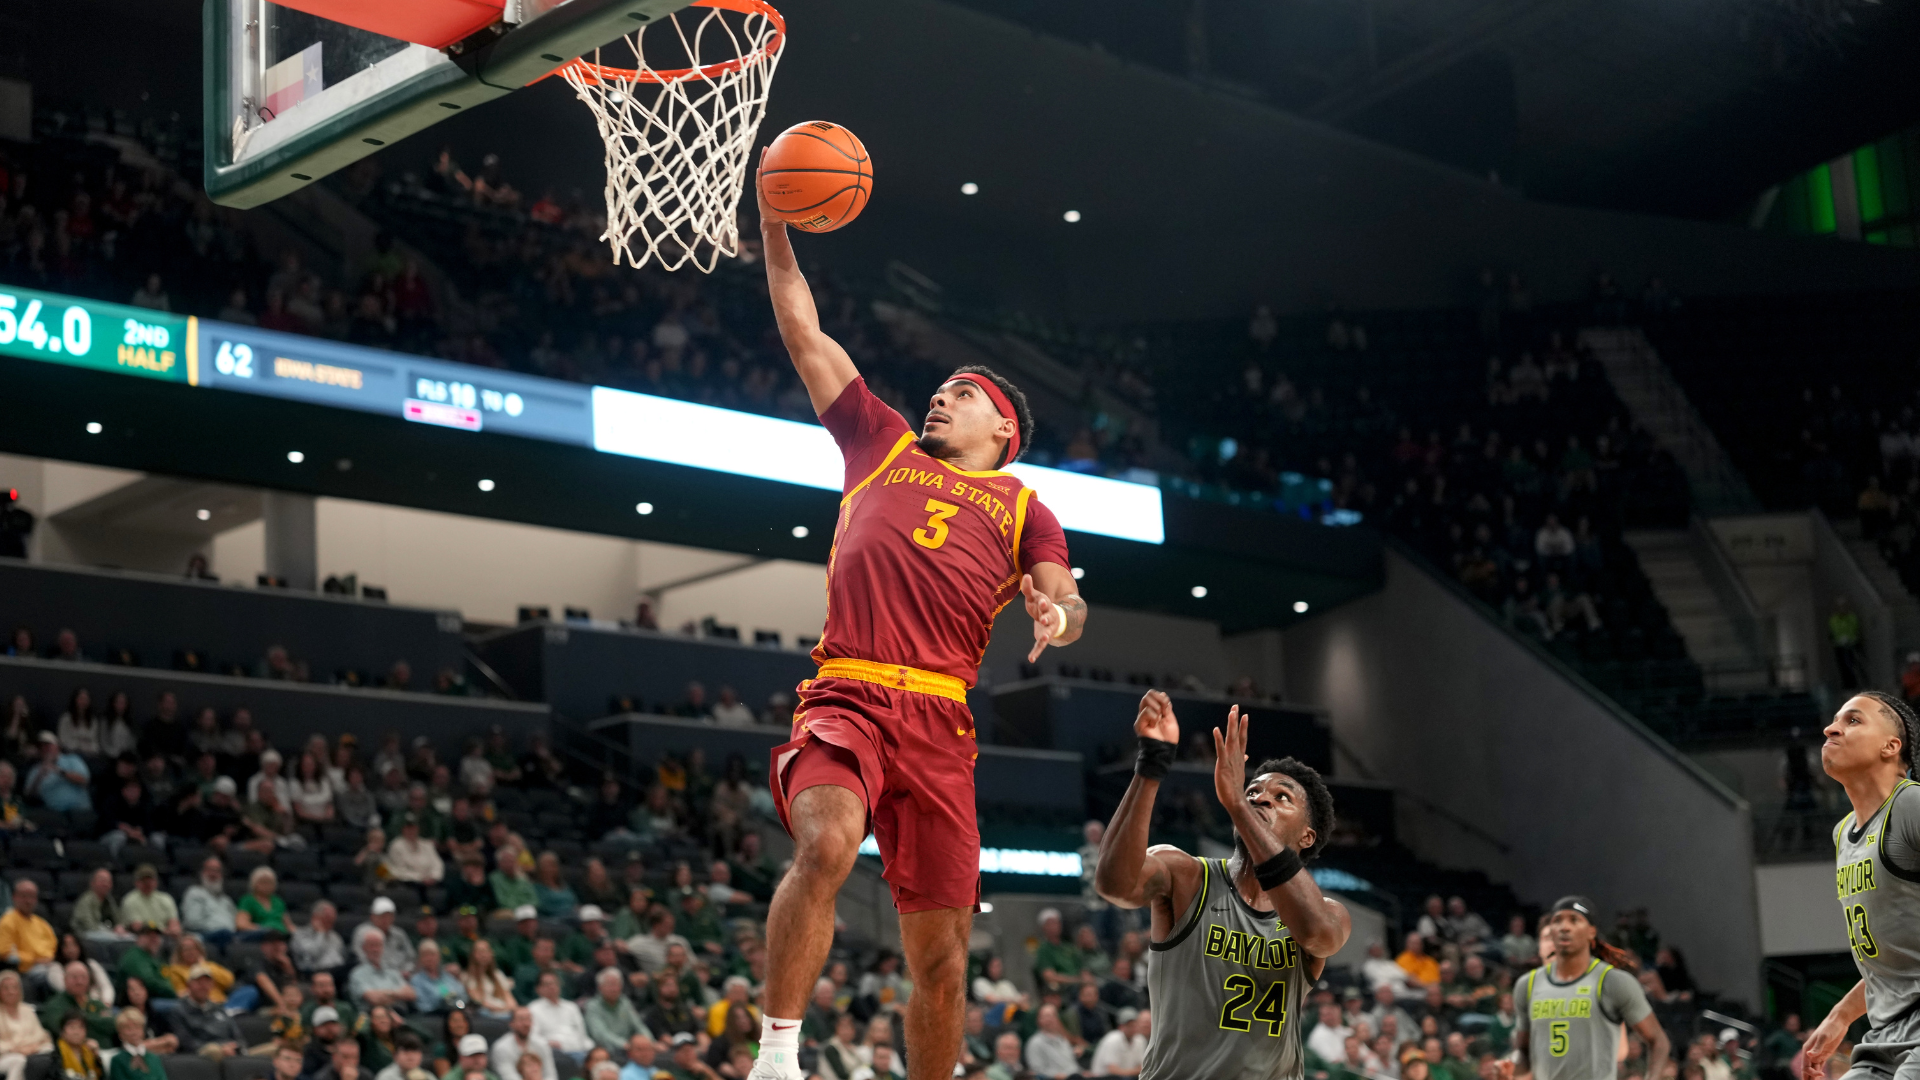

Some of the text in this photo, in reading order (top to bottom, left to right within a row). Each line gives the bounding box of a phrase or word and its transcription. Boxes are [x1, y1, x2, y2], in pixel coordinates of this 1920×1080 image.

[0, 293, 92, 356] 54.0
[123, 318, 170, 348] 2ND
[117, 343, 176, 372] HALF
[215, 340, 254, 378] 62
[883, 467, 1014, 537] IOWA STATE
[912, 498, 960, 549] 3
[1204, 923, 1297, 970] BAYLOR
[1219, 973, 1287, 1037] 24
[1531, 997, 1592, 1019] BAYLOR
[1549, 1021, 1570, 1057] 5
